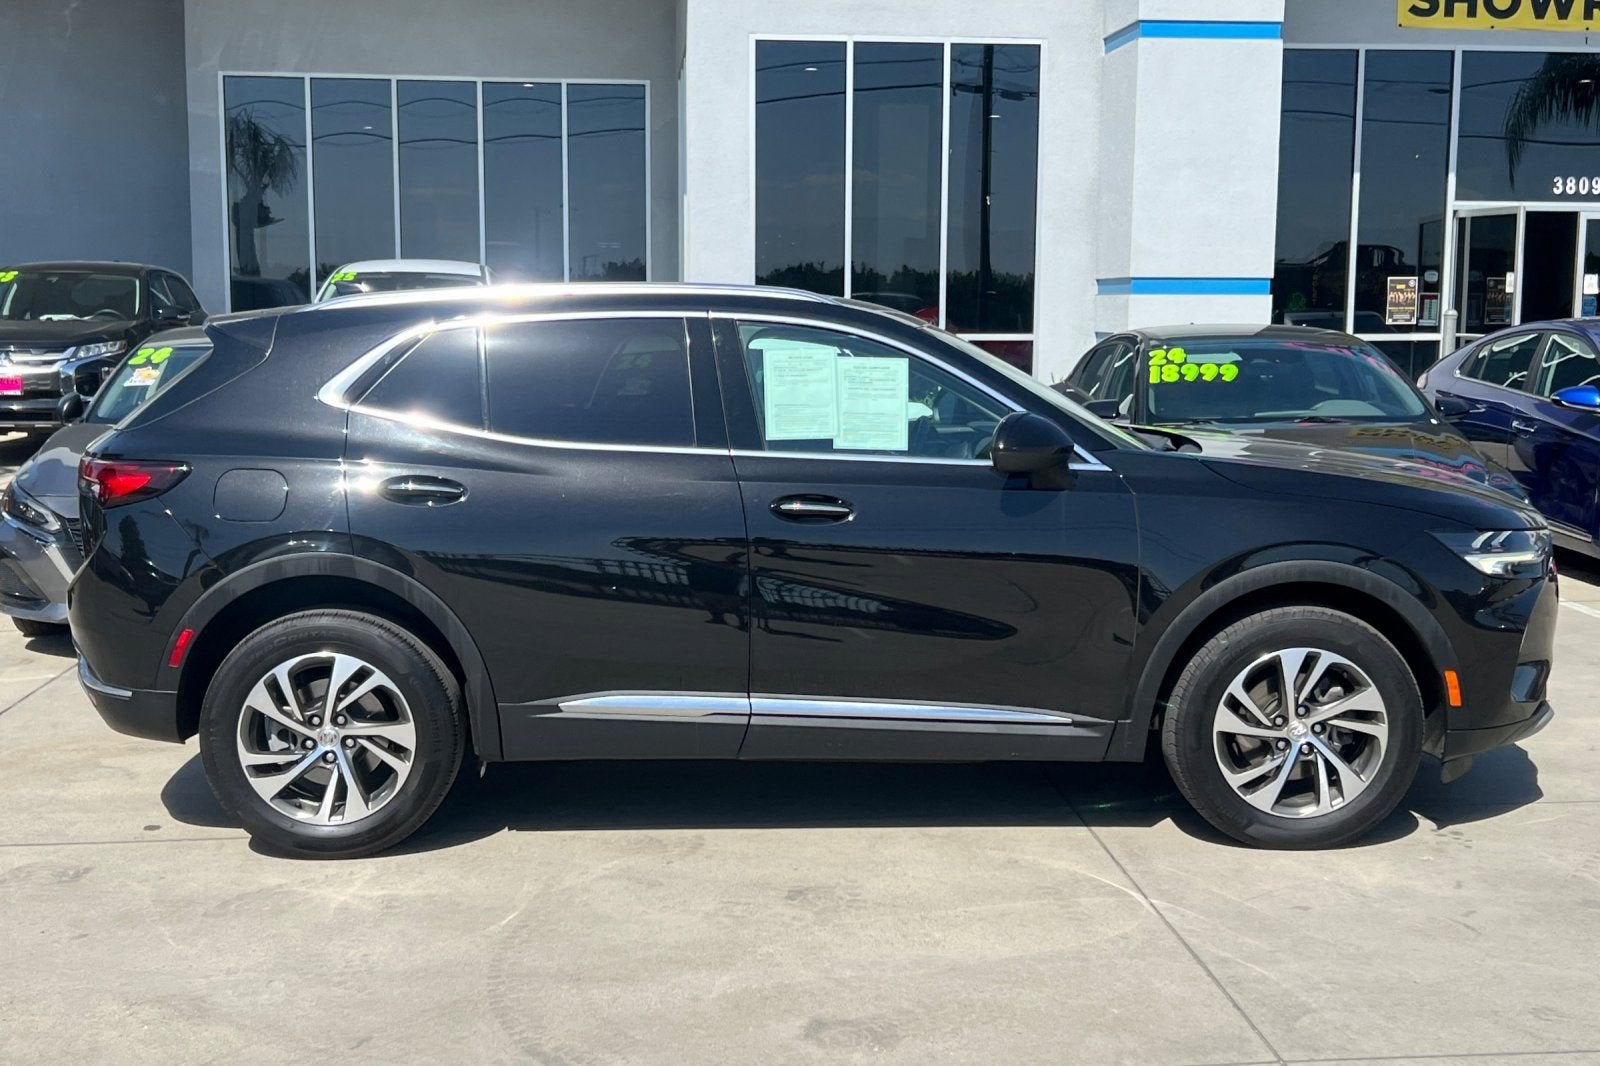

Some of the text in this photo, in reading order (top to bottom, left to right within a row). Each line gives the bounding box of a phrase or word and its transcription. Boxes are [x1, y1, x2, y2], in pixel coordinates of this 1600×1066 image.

[1408, 0, 1600, 20] SHOW
[1552, 176, 1600, 195] 3809
[1148, 347, 1187, 366] 24
[1148, 363, 1239, 383] 18999
